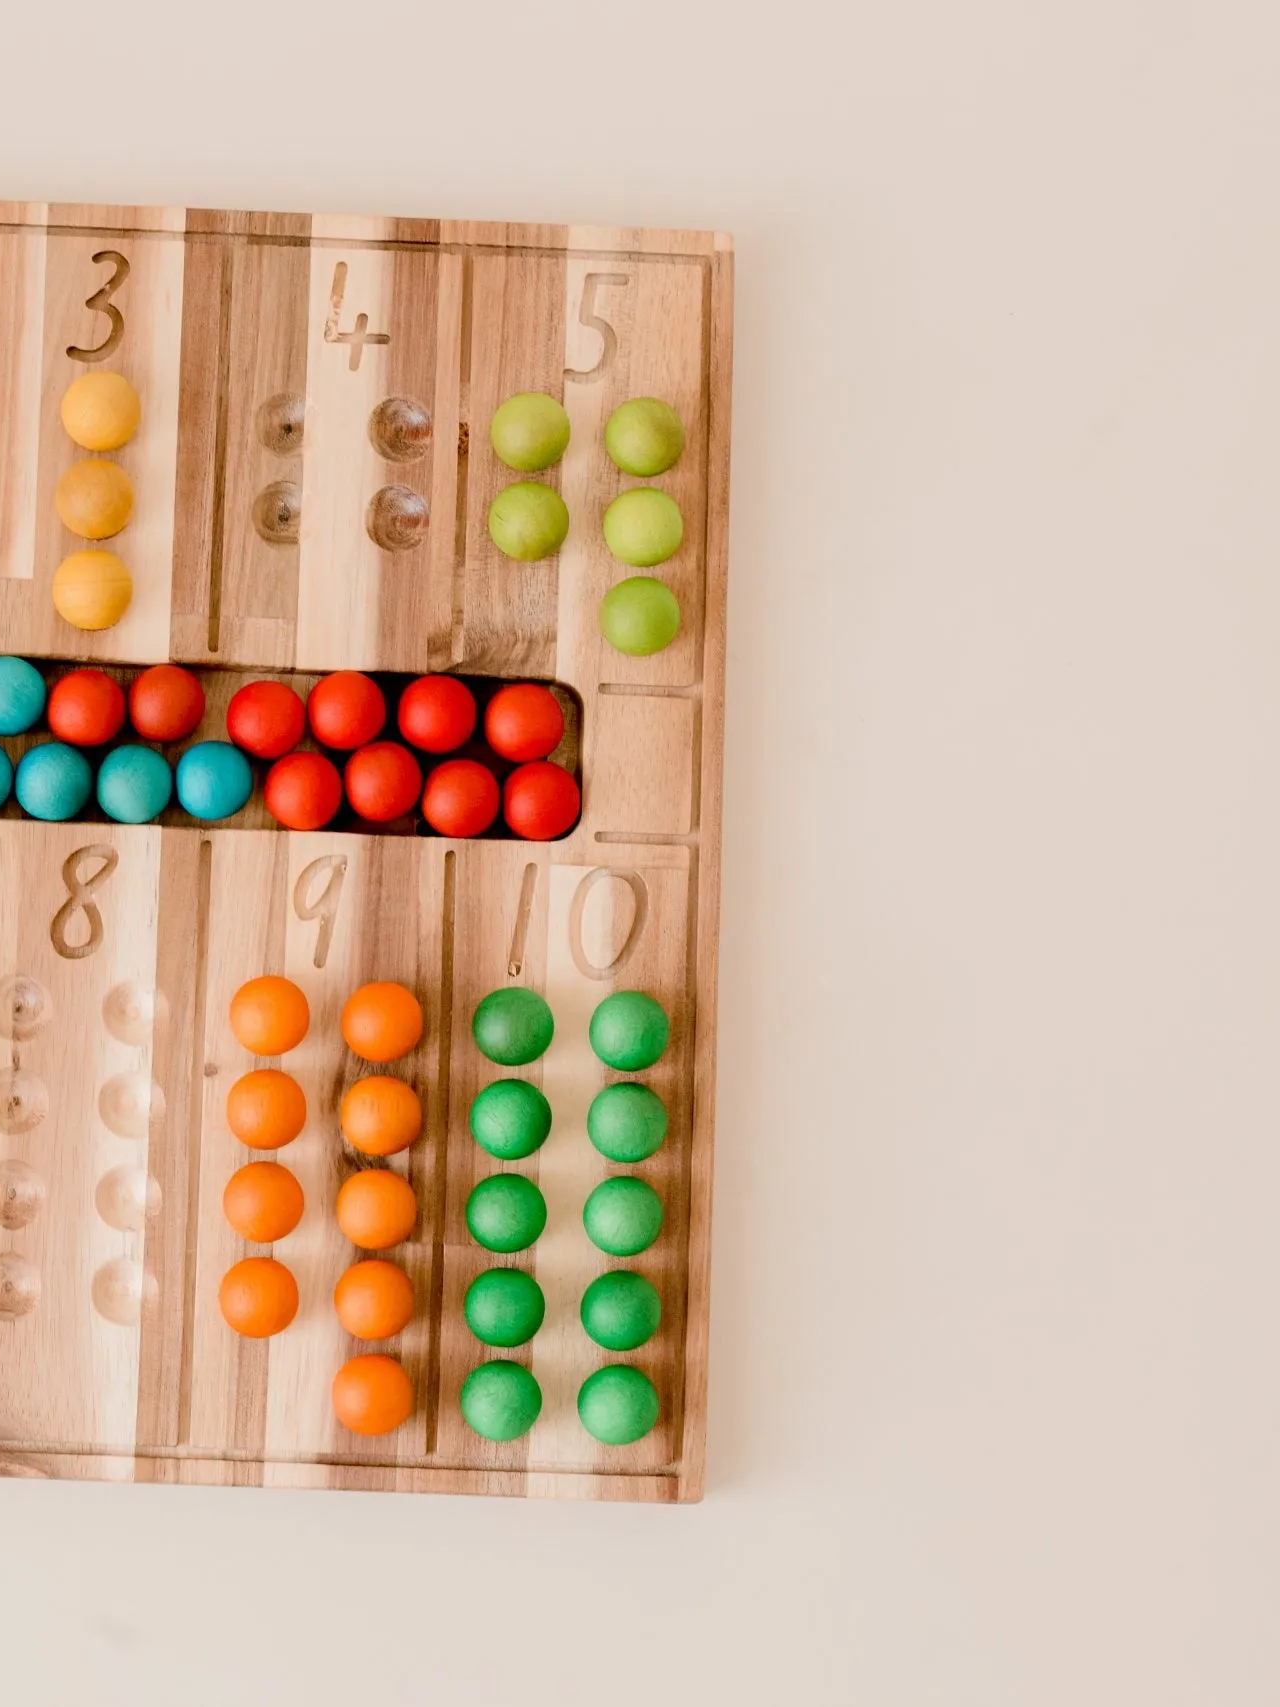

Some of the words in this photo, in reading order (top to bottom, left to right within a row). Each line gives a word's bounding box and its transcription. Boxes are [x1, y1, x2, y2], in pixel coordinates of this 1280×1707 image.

[66, 250, 131, 363] 3
[324, 261, 391, 372] 4
[563, 273, 630, 384] 5
[50, 843, 120, 960] 8
[294, 854, 348, 969] 9
[507, 862, 649, 981] 10
